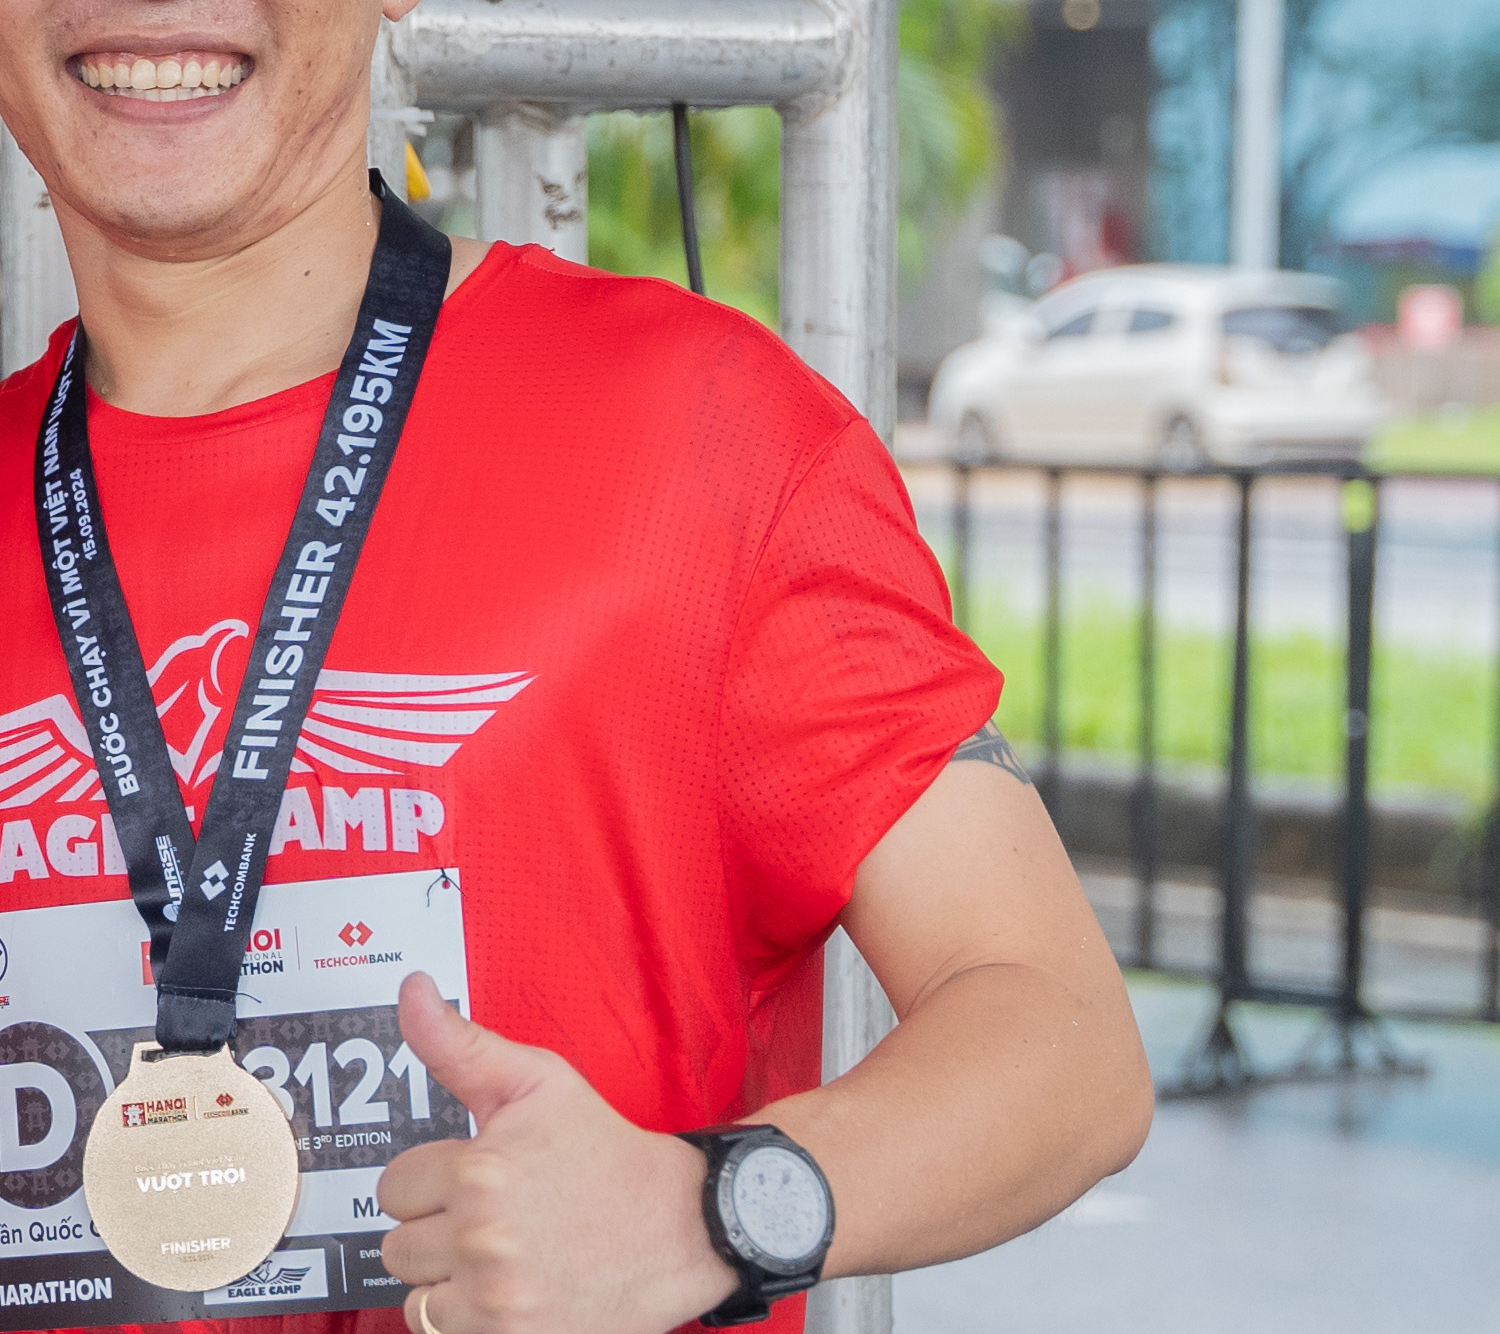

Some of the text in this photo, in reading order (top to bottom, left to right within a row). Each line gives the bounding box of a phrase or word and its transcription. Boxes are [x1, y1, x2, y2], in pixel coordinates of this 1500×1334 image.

[43, 421, 61, 477] NAM
[43, 479, 69, 536] VIỆT
[70, 467, 98, 561] 15.09.2024
[52, 537, 83, 596] MỘT
[232, 317, 413, 781] FINISHER 42.195KM
[62, 597, 91, 630] VÌ
[75, 634, 112, 708] CHẠY
[99, 712, 140, 797] BƯỚC
[268, 786, 447, 854] AMP
[223, 832, 258, 933] TECHCOMBANK
[238, 959, 284, 976] THON
[313, 951, 403, 969] TECHCOMBANK
[146, 1097, 187, 1113] HANOI
[231, 1037, 431, 1128] 3121
[295, 1137, 310, 1151] HE
[335, 1131, 392, 1148] EDITION
[29, 1216, 83, 1242] Quốc
[160, 1237, 231, 1255] FINISHER
[360, 1249, 383, 1259] EVEN
[228, 1284, 302, 1299] EAGLE CAMP
